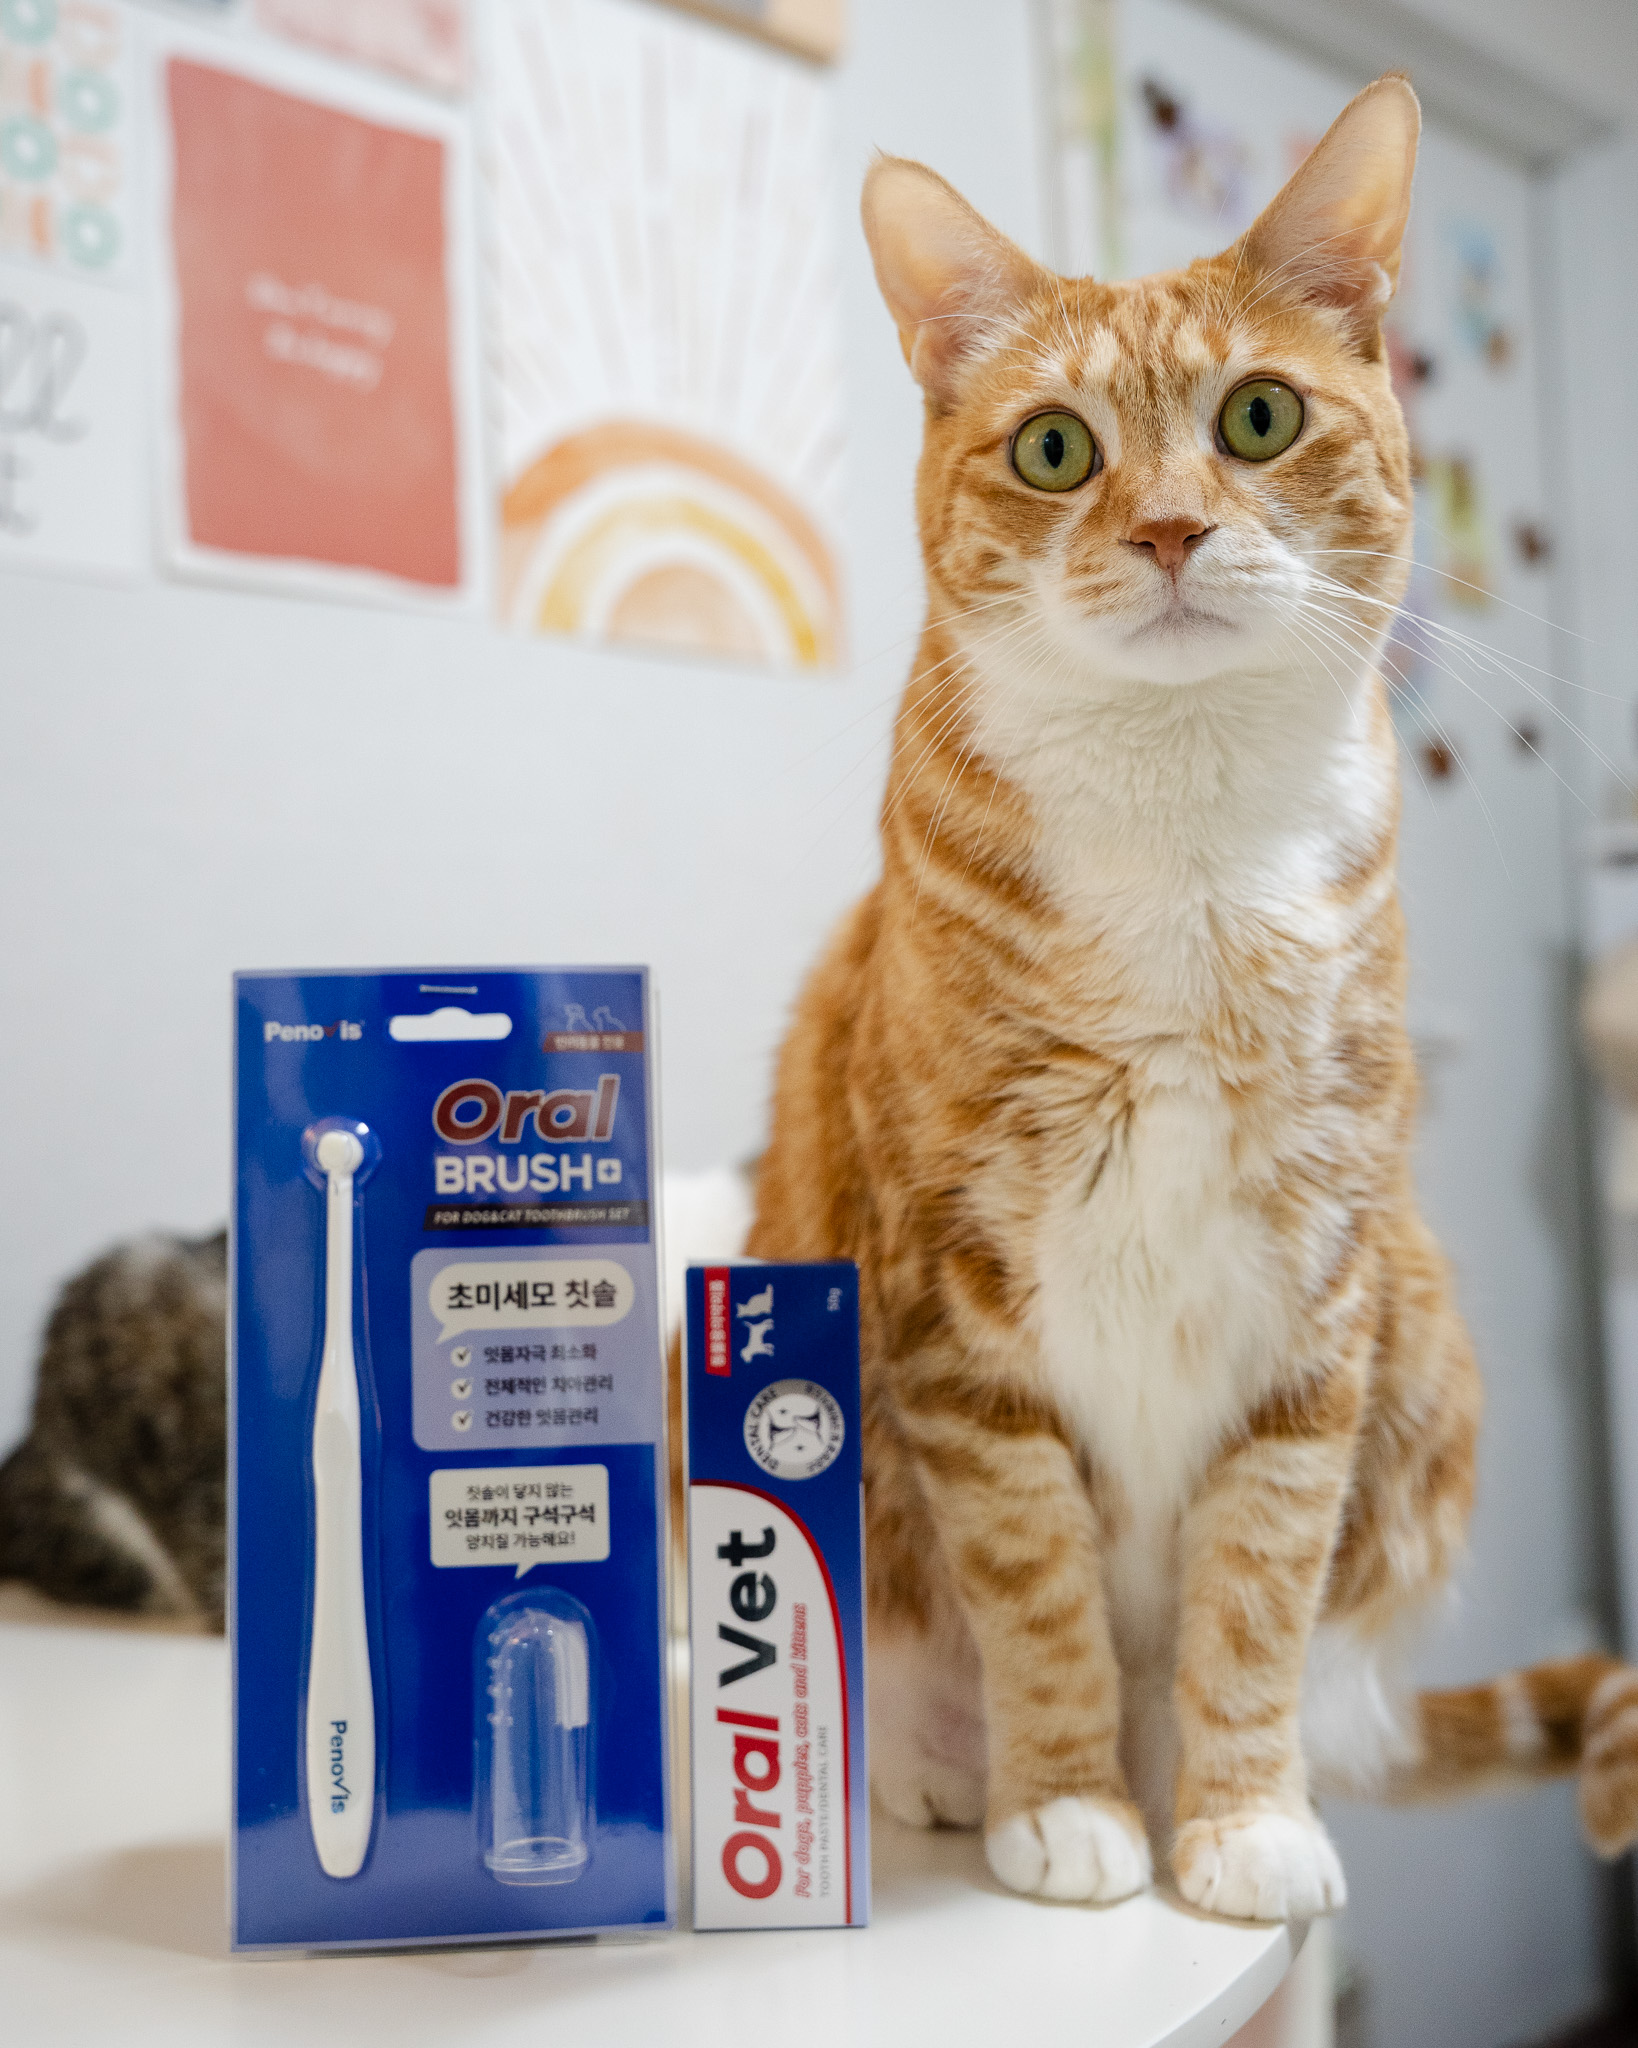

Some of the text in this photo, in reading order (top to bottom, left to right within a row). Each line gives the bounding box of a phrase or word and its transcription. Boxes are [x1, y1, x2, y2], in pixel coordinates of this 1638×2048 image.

[433, 1074, 620, 1145] Oral
[433, 1210, 460, 1225] FOR
[447, 1278, 618, 1311] 초미세모 칫솔
[484, 1344, 546, 1364] 잇몸자극
[485, 1376, 547, 1396] 전체적인
[486, 1406, 599, 1428] 건강한 잇몸관리
[467, 1484, 510, 1501] 칫솔이
[445, 1502, 595, 1529] 잇몸까지 구석구석
[716, 1526, 782, 1900] Oral Vet
[789, 1603, 813, 1898] For dogs, puppies, cats and kittens
[816, 1725, 829, 1757] CARE
[818, 1854, 830, 1898] TOOTH
